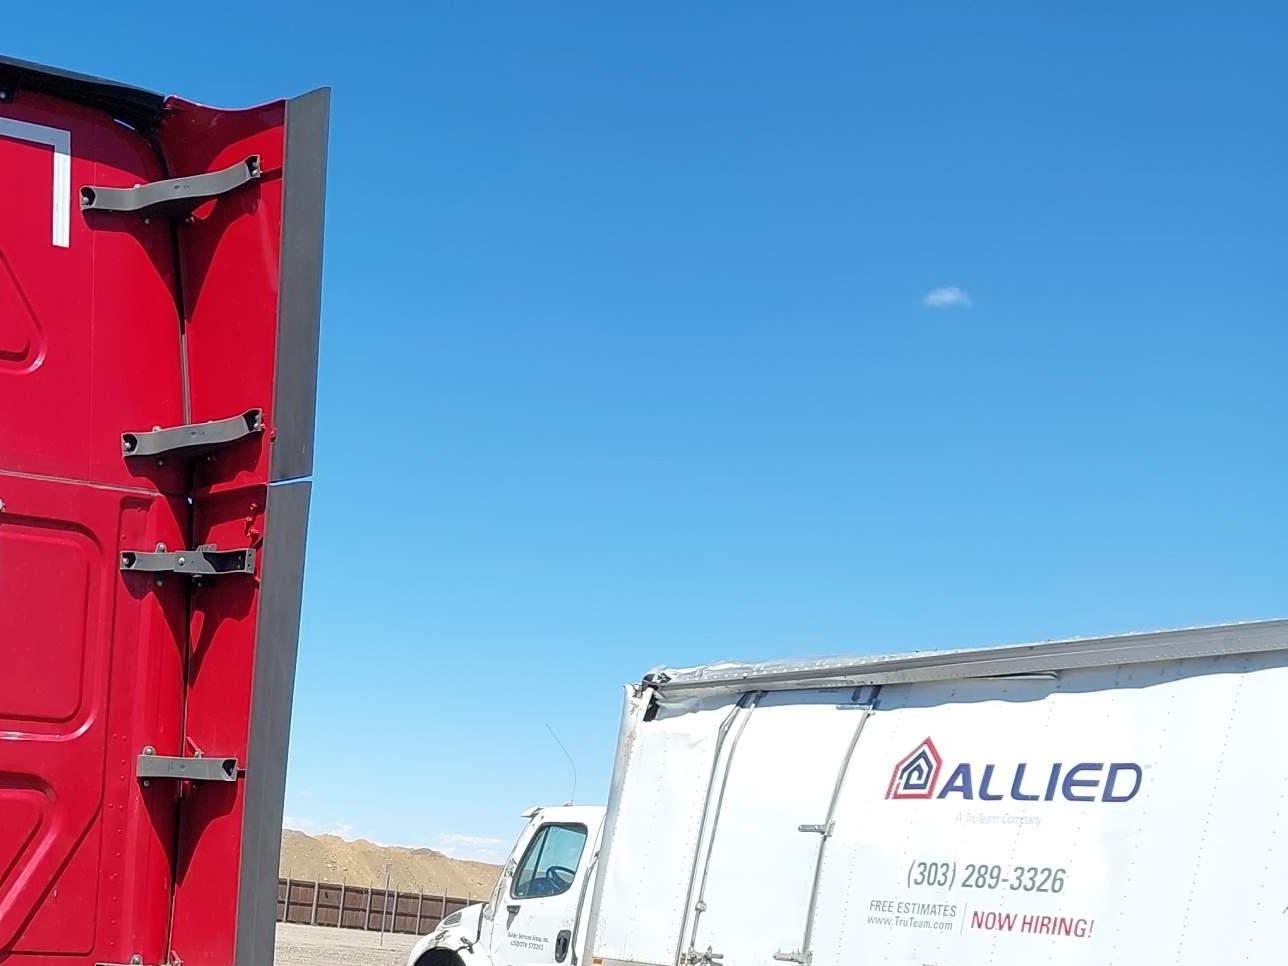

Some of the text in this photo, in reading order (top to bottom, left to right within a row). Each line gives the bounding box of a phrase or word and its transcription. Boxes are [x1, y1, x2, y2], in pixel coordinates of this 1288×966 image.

[936, 762, 1143, 802] ALLIED
[907, 860, 1067, 894] (303) 289-3326
[869, 899, 957, 917] FREE ESTIMATES
[867, 916, 953, 930] www.TruTeam.com
[970, 911, 1095, 938] NOW HIRING!
